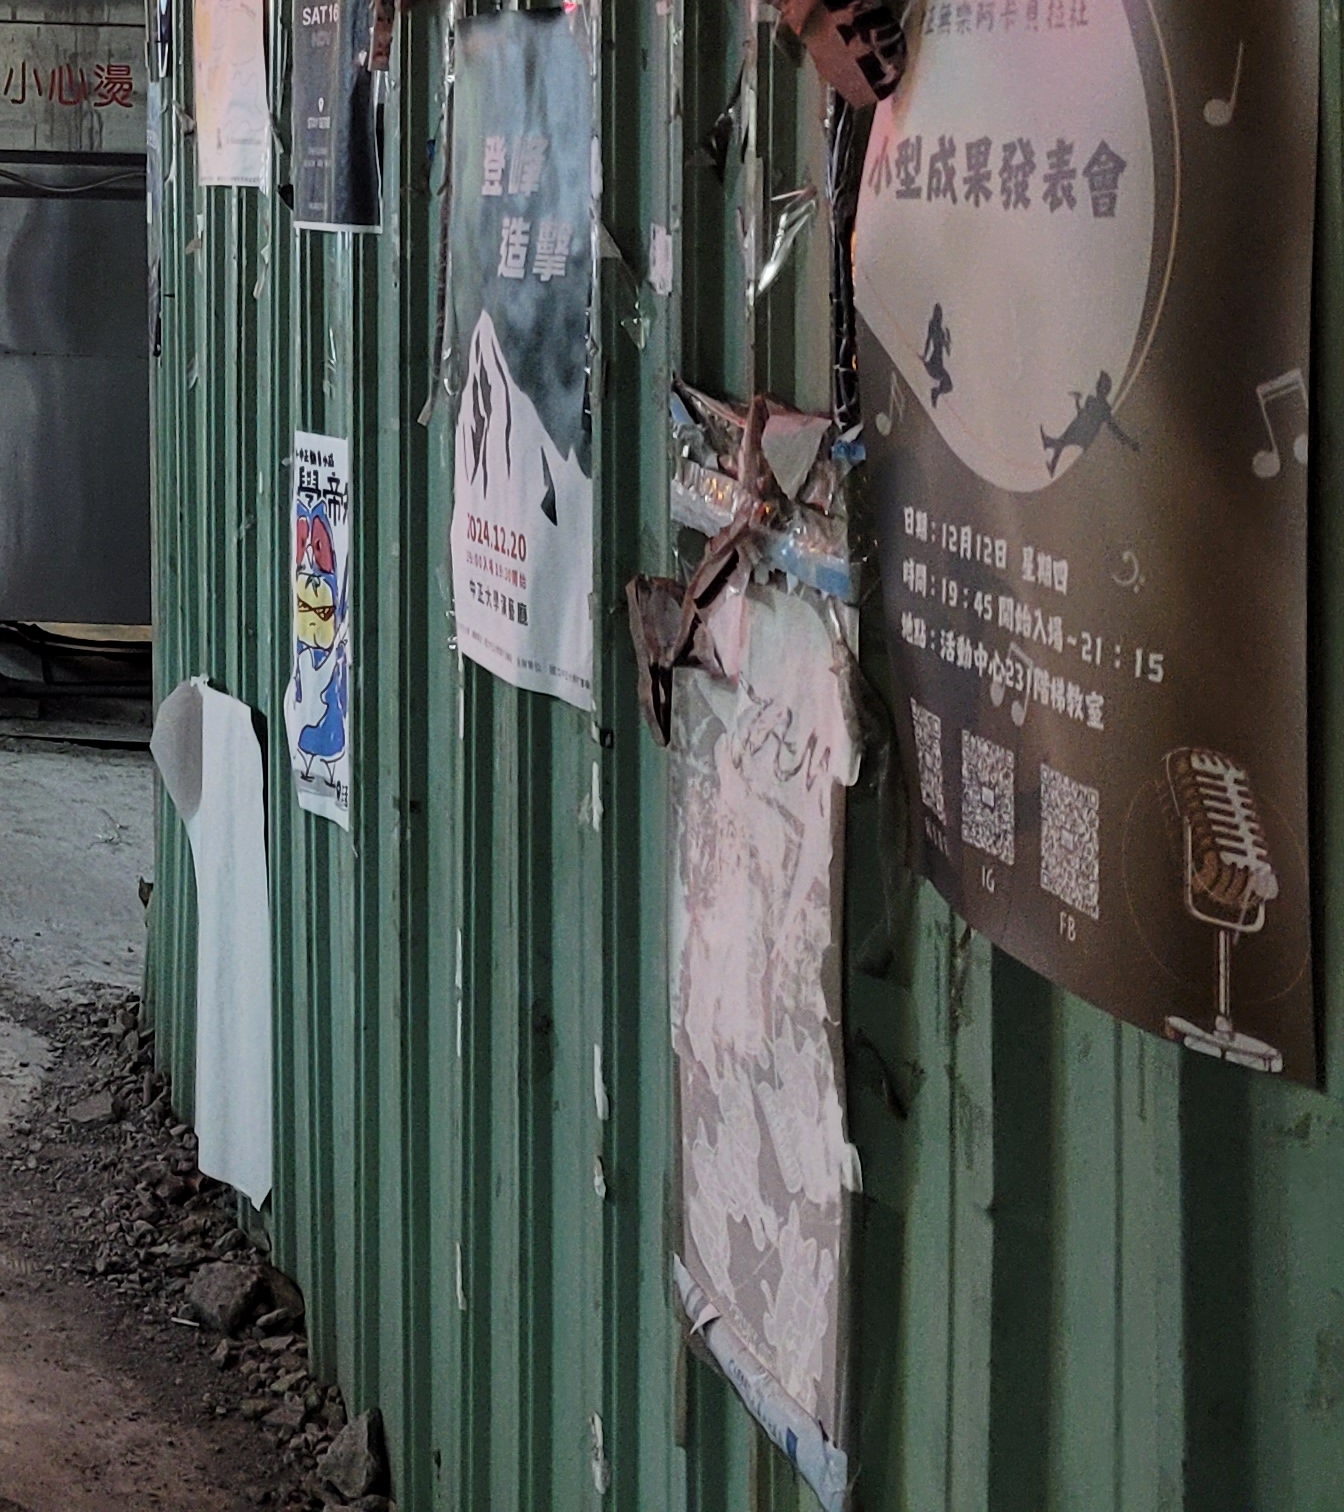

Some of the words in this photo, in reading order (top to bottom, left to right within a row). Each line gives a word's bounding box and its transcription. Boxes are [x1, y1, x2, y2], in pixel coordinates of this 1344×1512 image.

[3, 61, 134, 109] 小心燙
[1059, 911, 1077, 942] FB
